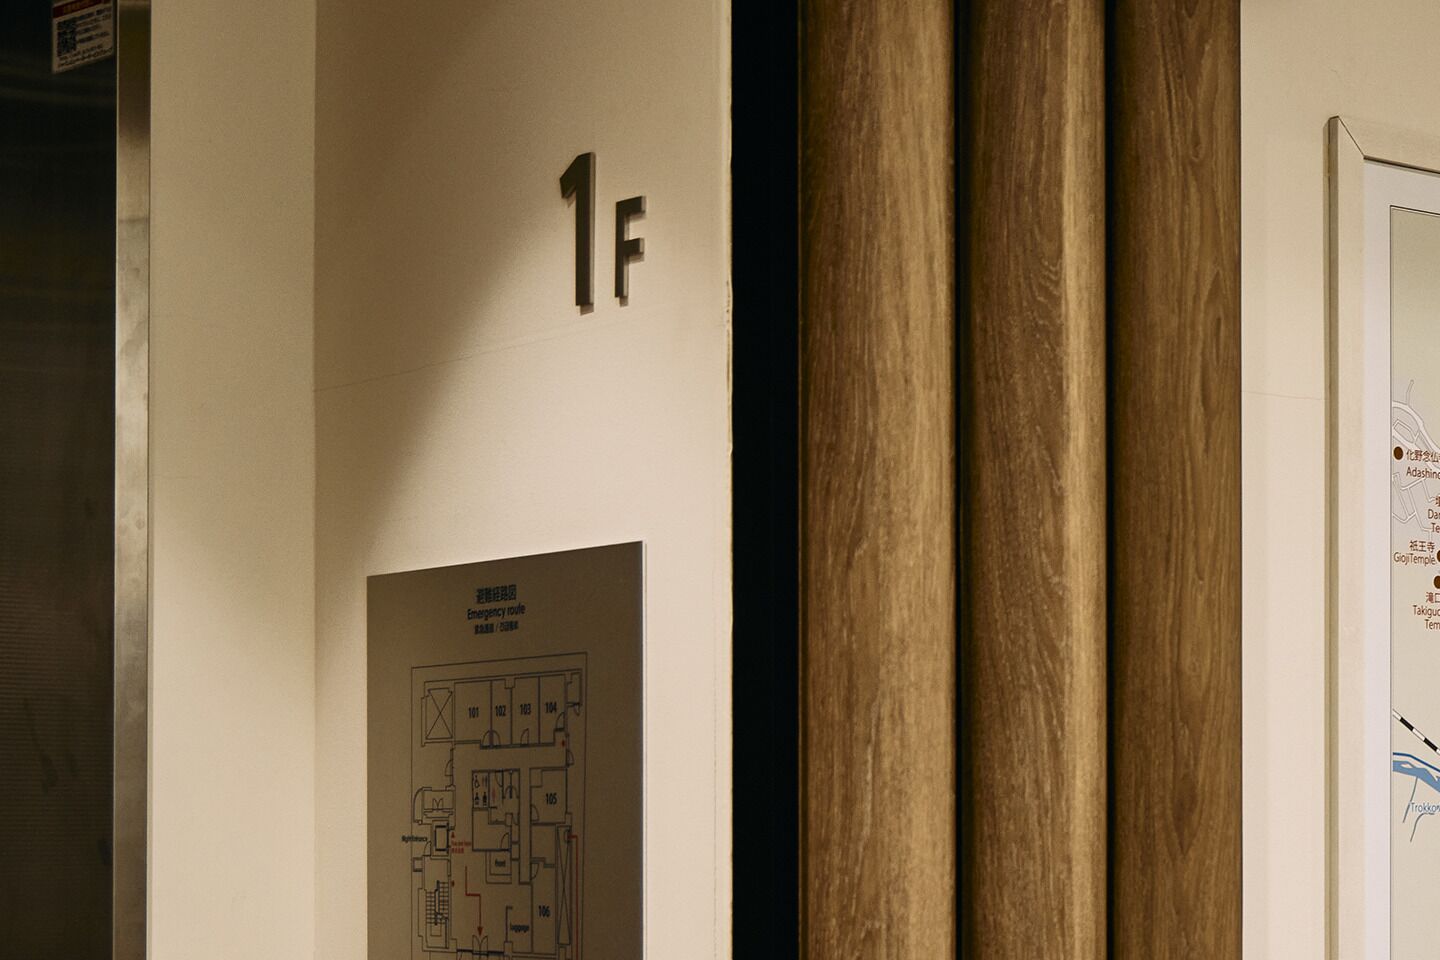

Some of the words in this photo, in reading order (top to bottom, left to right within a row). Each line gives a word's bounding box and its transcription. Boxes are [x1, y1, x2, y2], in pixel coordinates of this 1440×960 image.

[560, 152, 646, 306] 1F
[468, 606, 505, 620] Emergency
[507, 603, 525, 616] route
[495, 706, 506, 716] 102
[520, 704, 531, 714] 103
[546, 702, 556, 713] 104
[468, 708, 479, 718] 101
[546, 794, 557, 804] 105
[538, 906, 549, 917] 106
